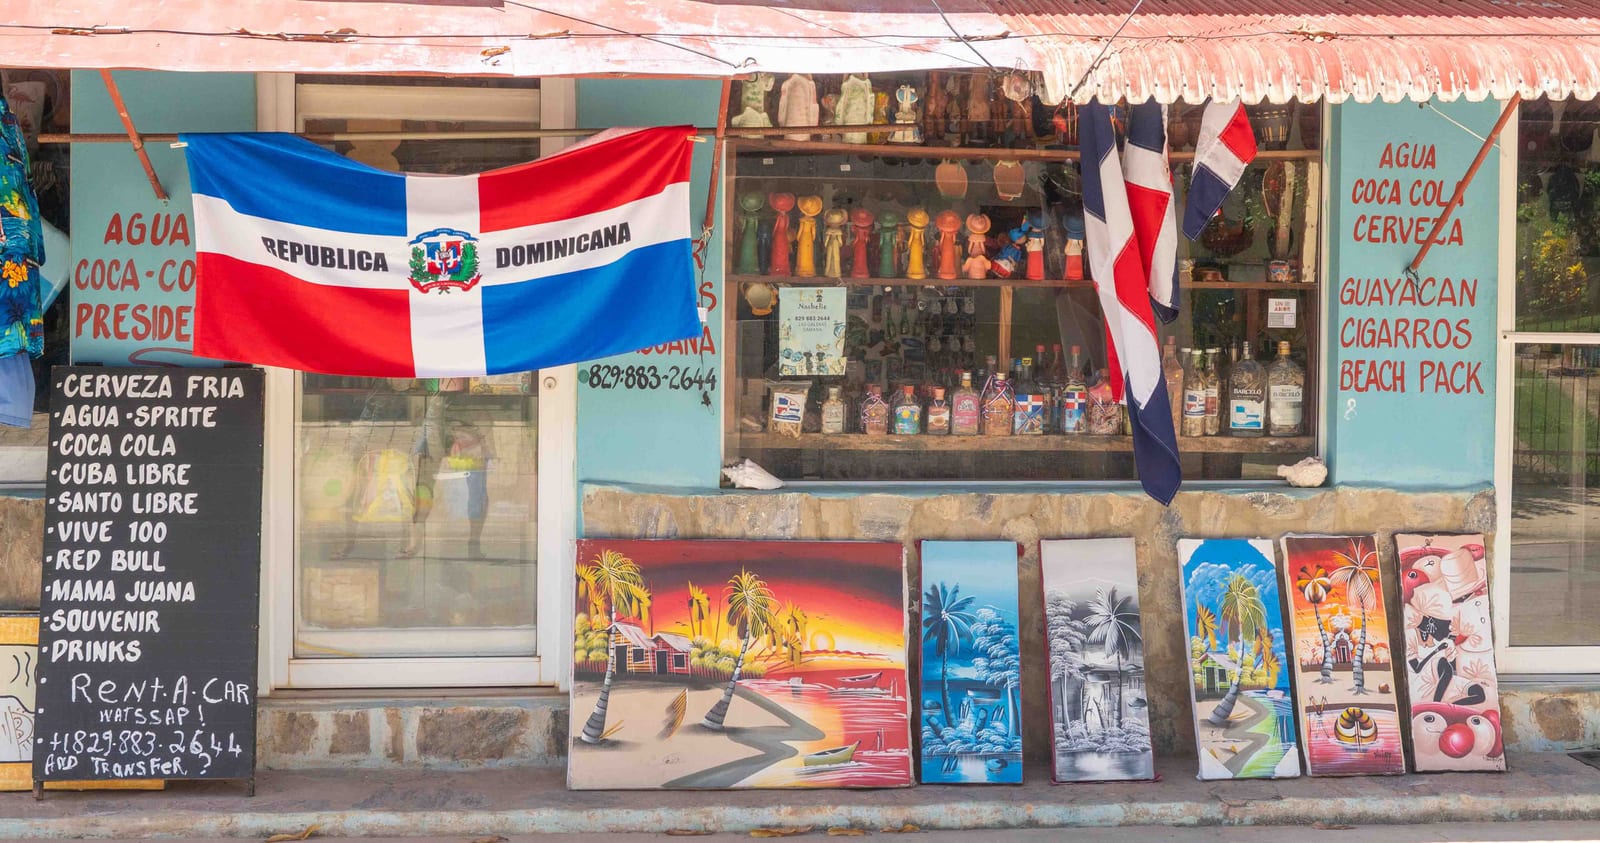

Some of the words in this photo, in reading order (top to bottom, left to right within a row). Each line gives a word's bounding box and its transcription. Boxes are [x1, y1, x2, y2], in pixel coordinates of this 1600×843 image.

[1380, 143, 1435, 168] AGUA
[1352, 179, 1400, 204] COCA
[104, 214, 189, 245] AGUA
[1353, 214, 1464, 246] CERVEZA
[261, 236, 389, 272] REPUBLICA
[496, 222, 631, 269] DOMINICANA
[1341, 278, 1477, 306] GUAYACAN
[74, 302, 196, 343] PRESIDE
[1341, 318, 1471, 348] CIGARROS
[64, 374, 172, 398] CERVEZA
[187, 376, 244, 398] FRIA
[1341, 360, 1405, 392] BEACH
[1420, 361, 1483, 394] PACK
[61, 405, 118, 427] AGUA
[134, 406, 217, 427] SPRITE
[60, 433, 112, 456] COCA
[120, 434, 176, 456] COLA
[59, 463, 117, 484] CUBA
[127, 463, 191, 485] LIBRE
[58, 491, 122, 512] SANTO
[133, 492, 198, 514] LIBRE
[58, 521, 113, 542] VIVE
[129, 521, 167, 543] 100
[56, 549, 101, 571] RED
[111, 550, 165, 572] BULL
[51, 579, 115, 601] MAMA
[125, 581, 195, 602] JUANA
[50, 609, 160, 633] SOUVENIR
[52, 639, 141, 662] DRINKS
[198, 752, 211, 774] ?
